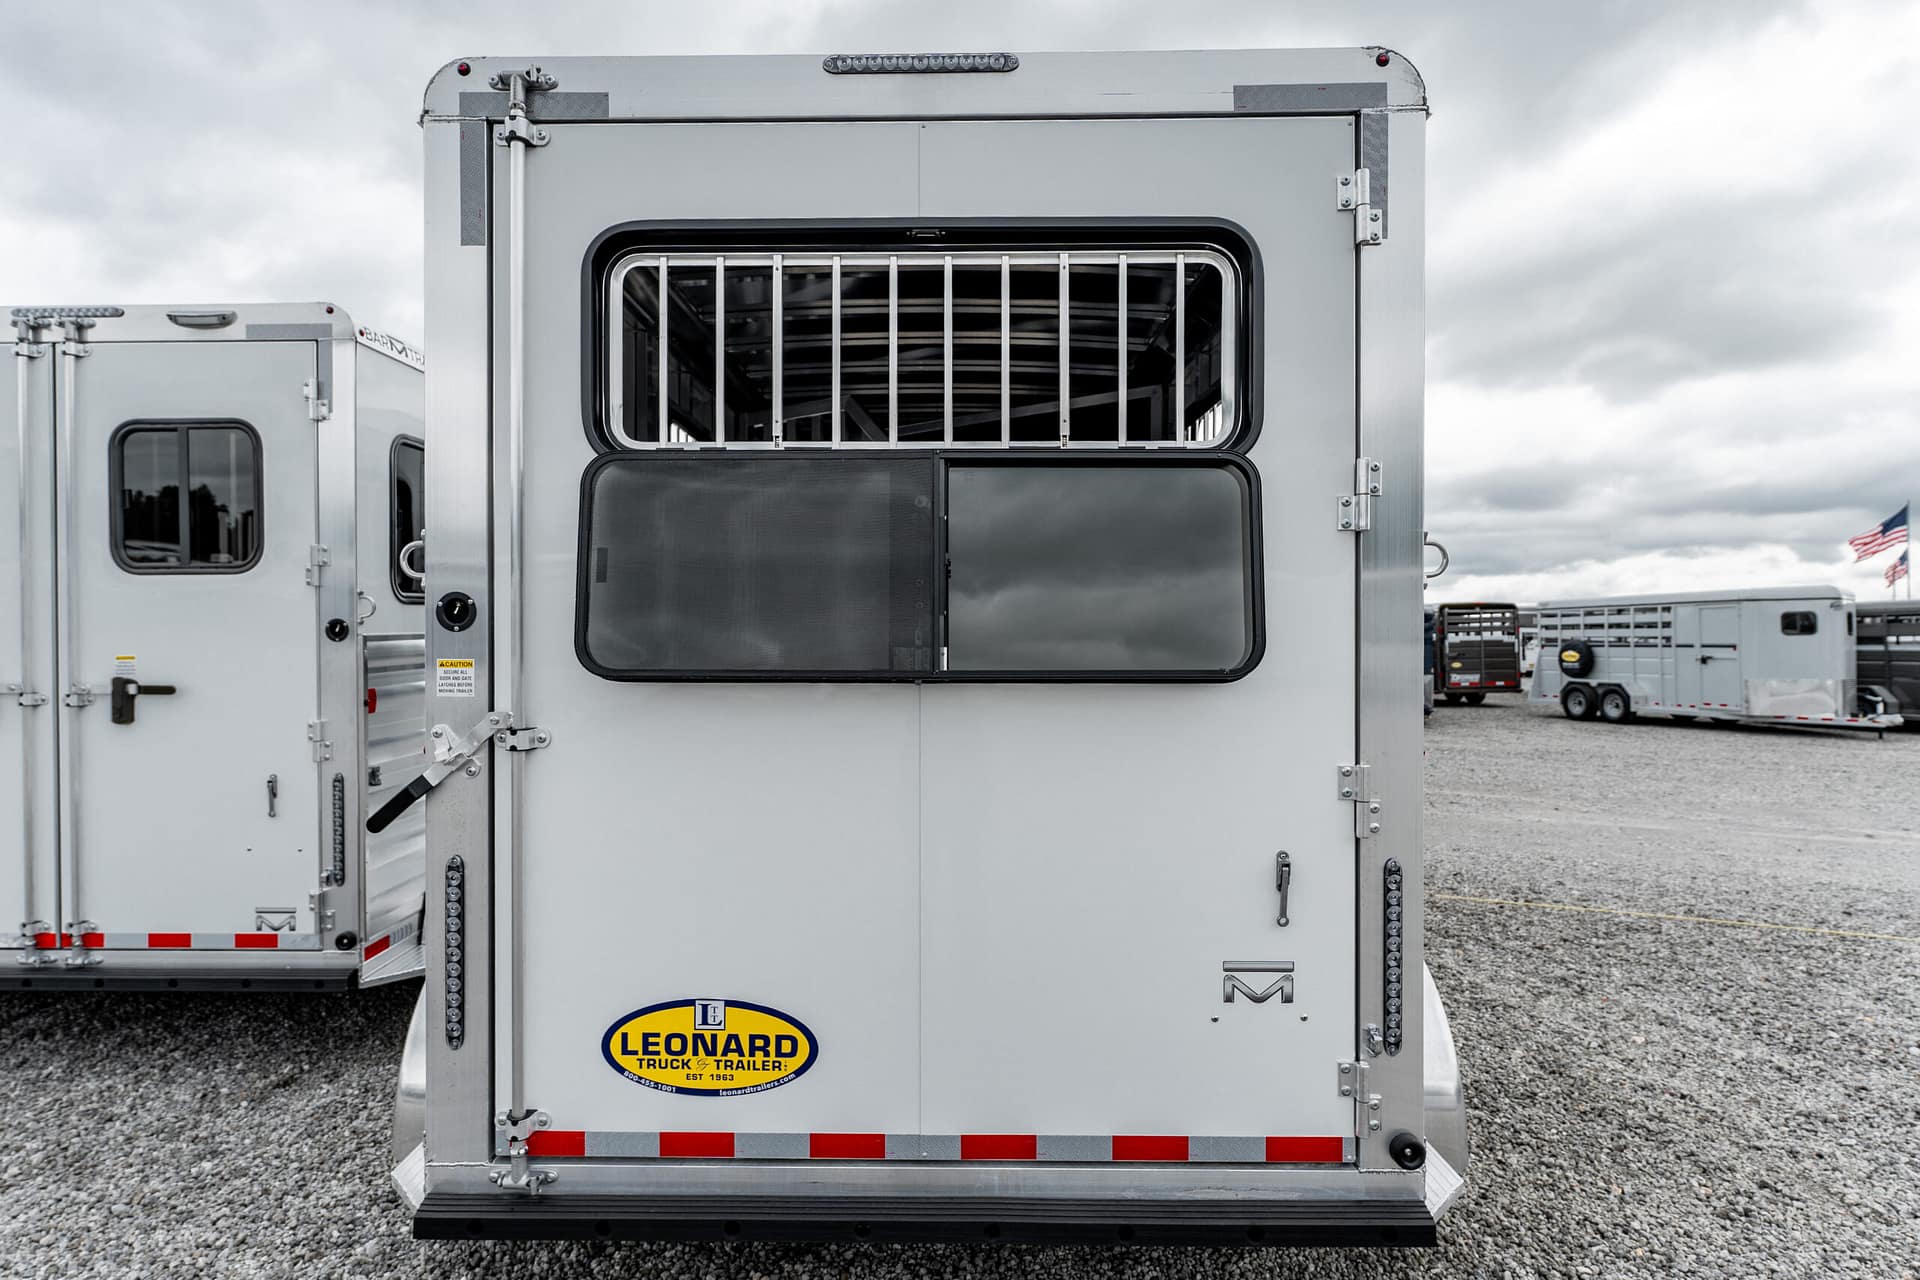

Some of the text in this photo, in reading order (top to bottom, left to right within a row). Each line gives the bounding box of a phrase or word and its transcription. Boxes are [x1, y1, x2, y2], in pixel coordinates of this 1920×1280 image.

[621, 1031, 799, 1058] LEONARD
[636, 1058, 692, 1070] TRUCK
[713, 1059, 782, 1072] TRAILER
[623, 1070, 677, 1094] 800-455-1001
[685, 1073, 735, 1082] EST 1963
[719, 1073, 797, 1097] leonardtrailers.com
